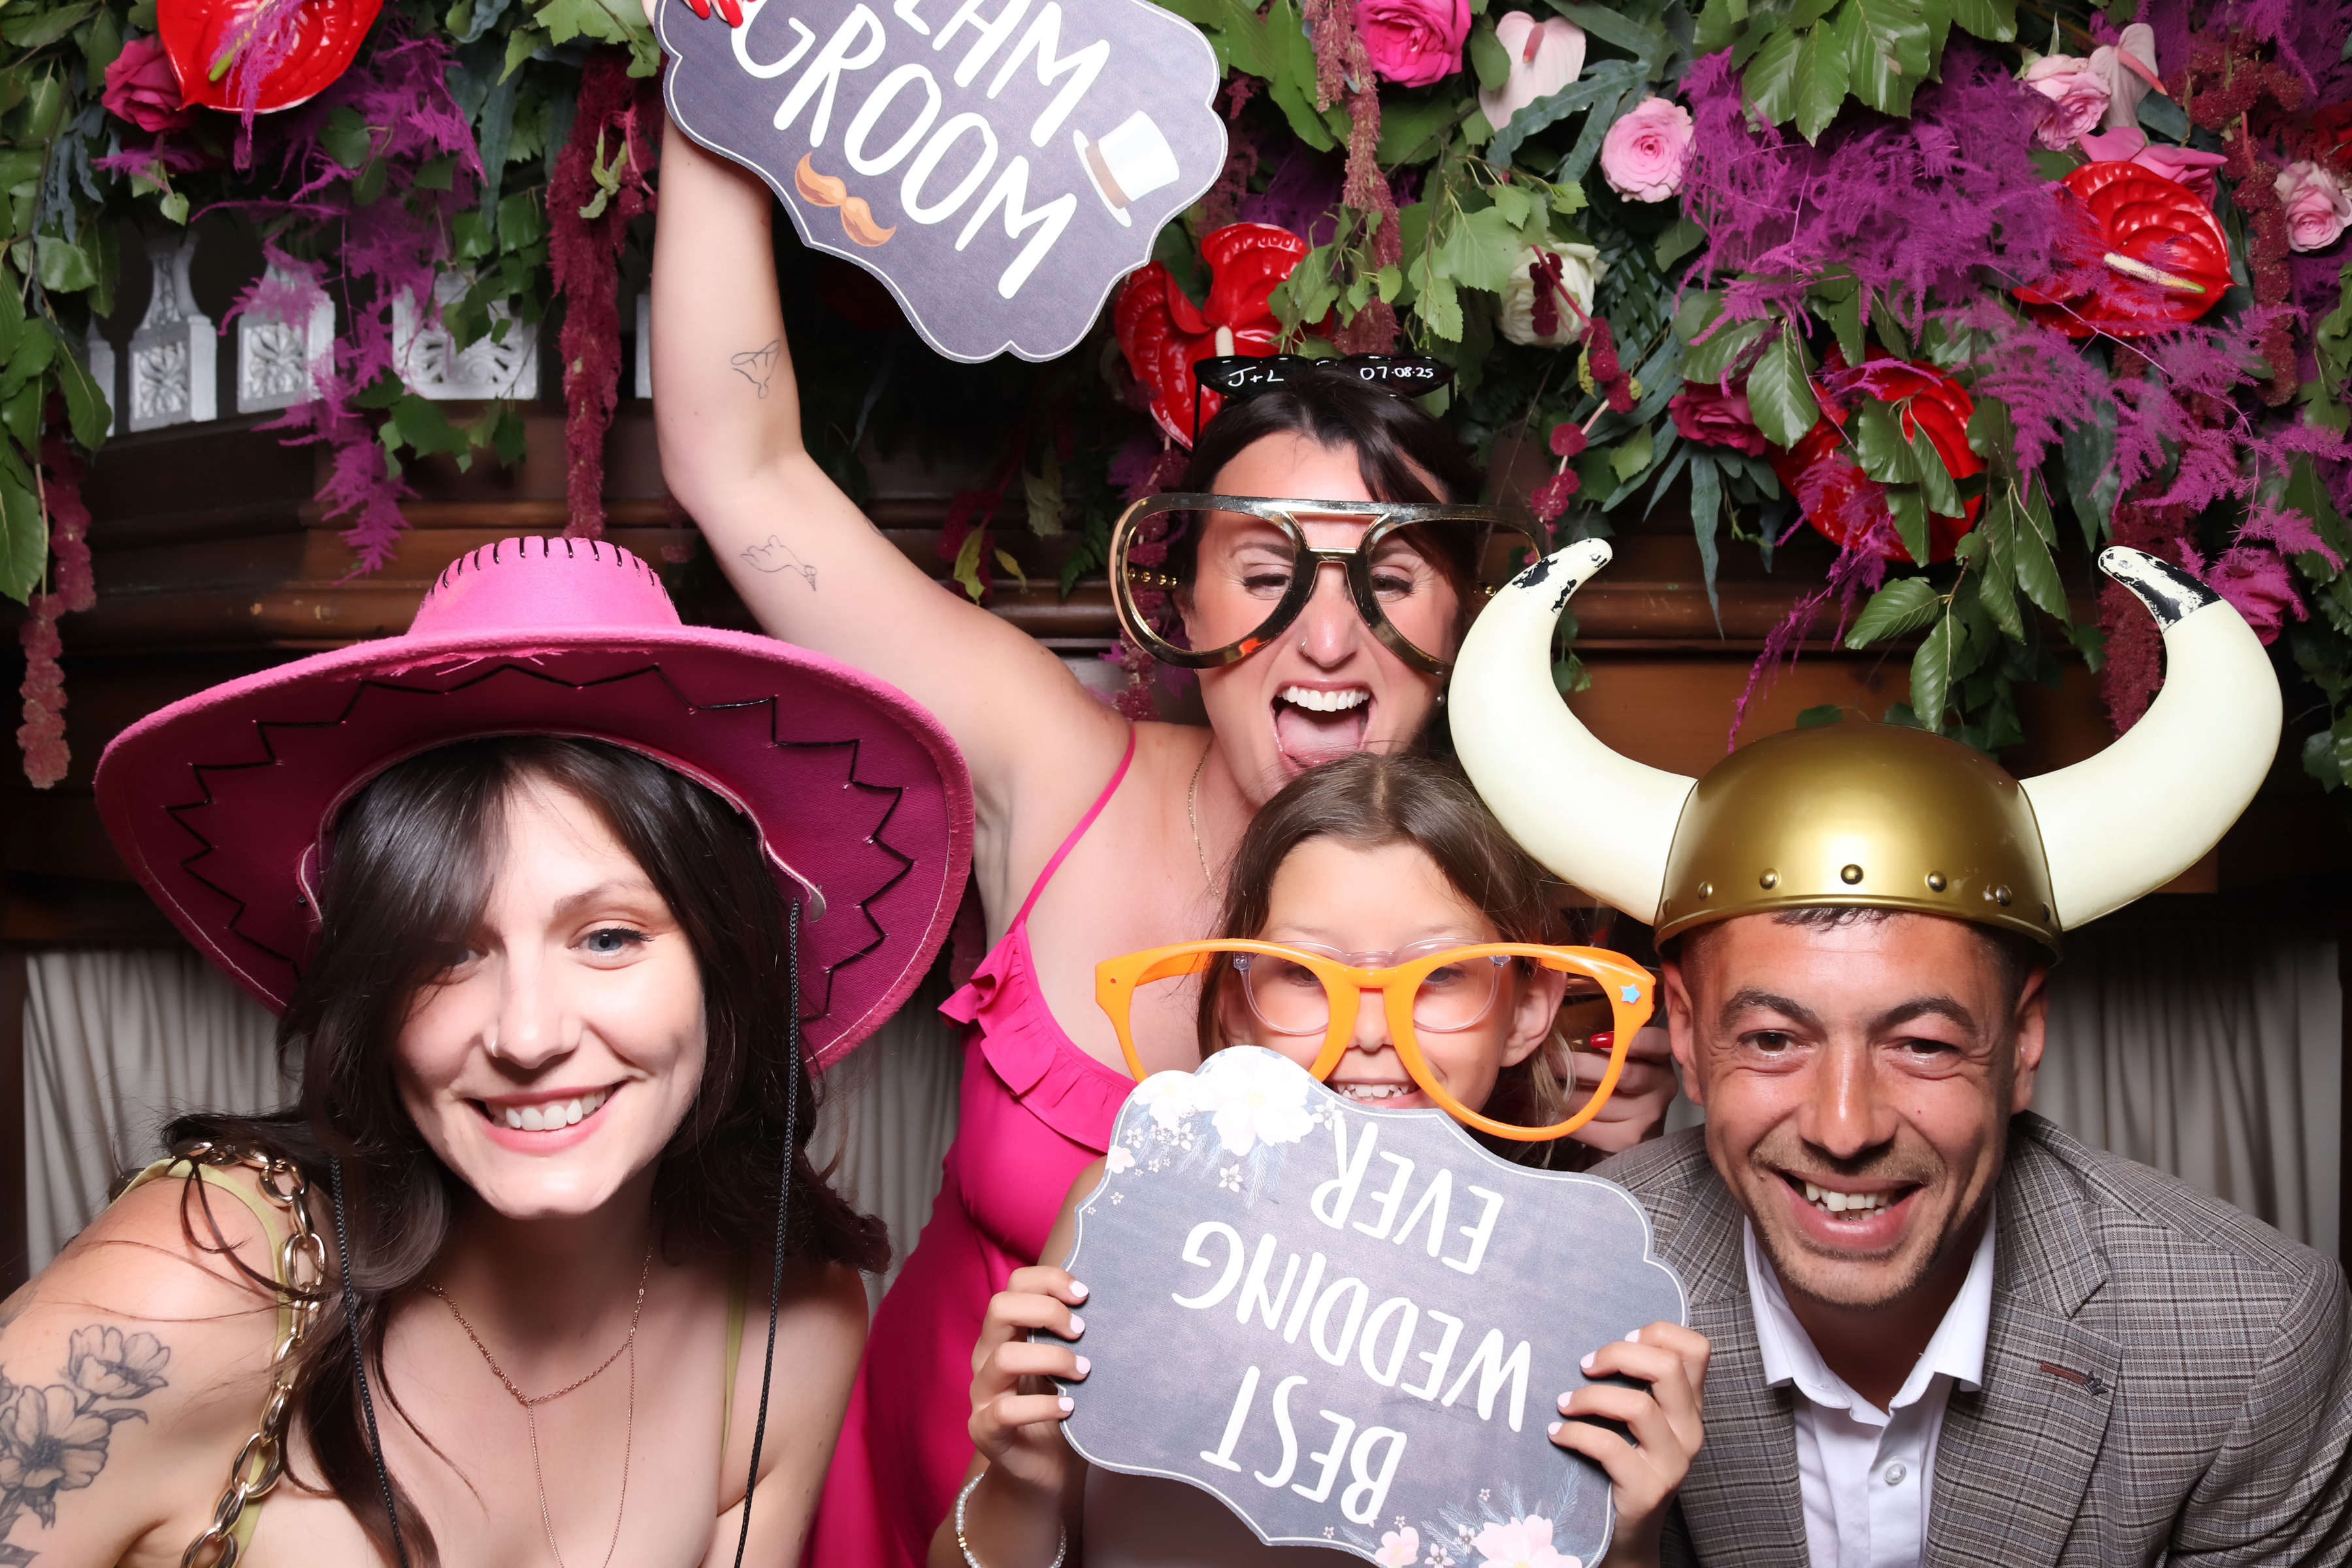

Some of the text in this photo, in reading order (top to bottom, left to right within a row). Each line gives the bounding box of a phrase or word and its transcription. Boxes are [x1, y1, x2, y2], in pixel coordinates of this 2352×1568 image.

[730, 0, 1077, 300] GROOM
[892, 0, 1111, 148] AM
[1310, 1115, 1505, 1275] EVER
[1171, 1220, 1531, 1433] WEDDING
[1200, 1365, 1407, 1526] BEST
